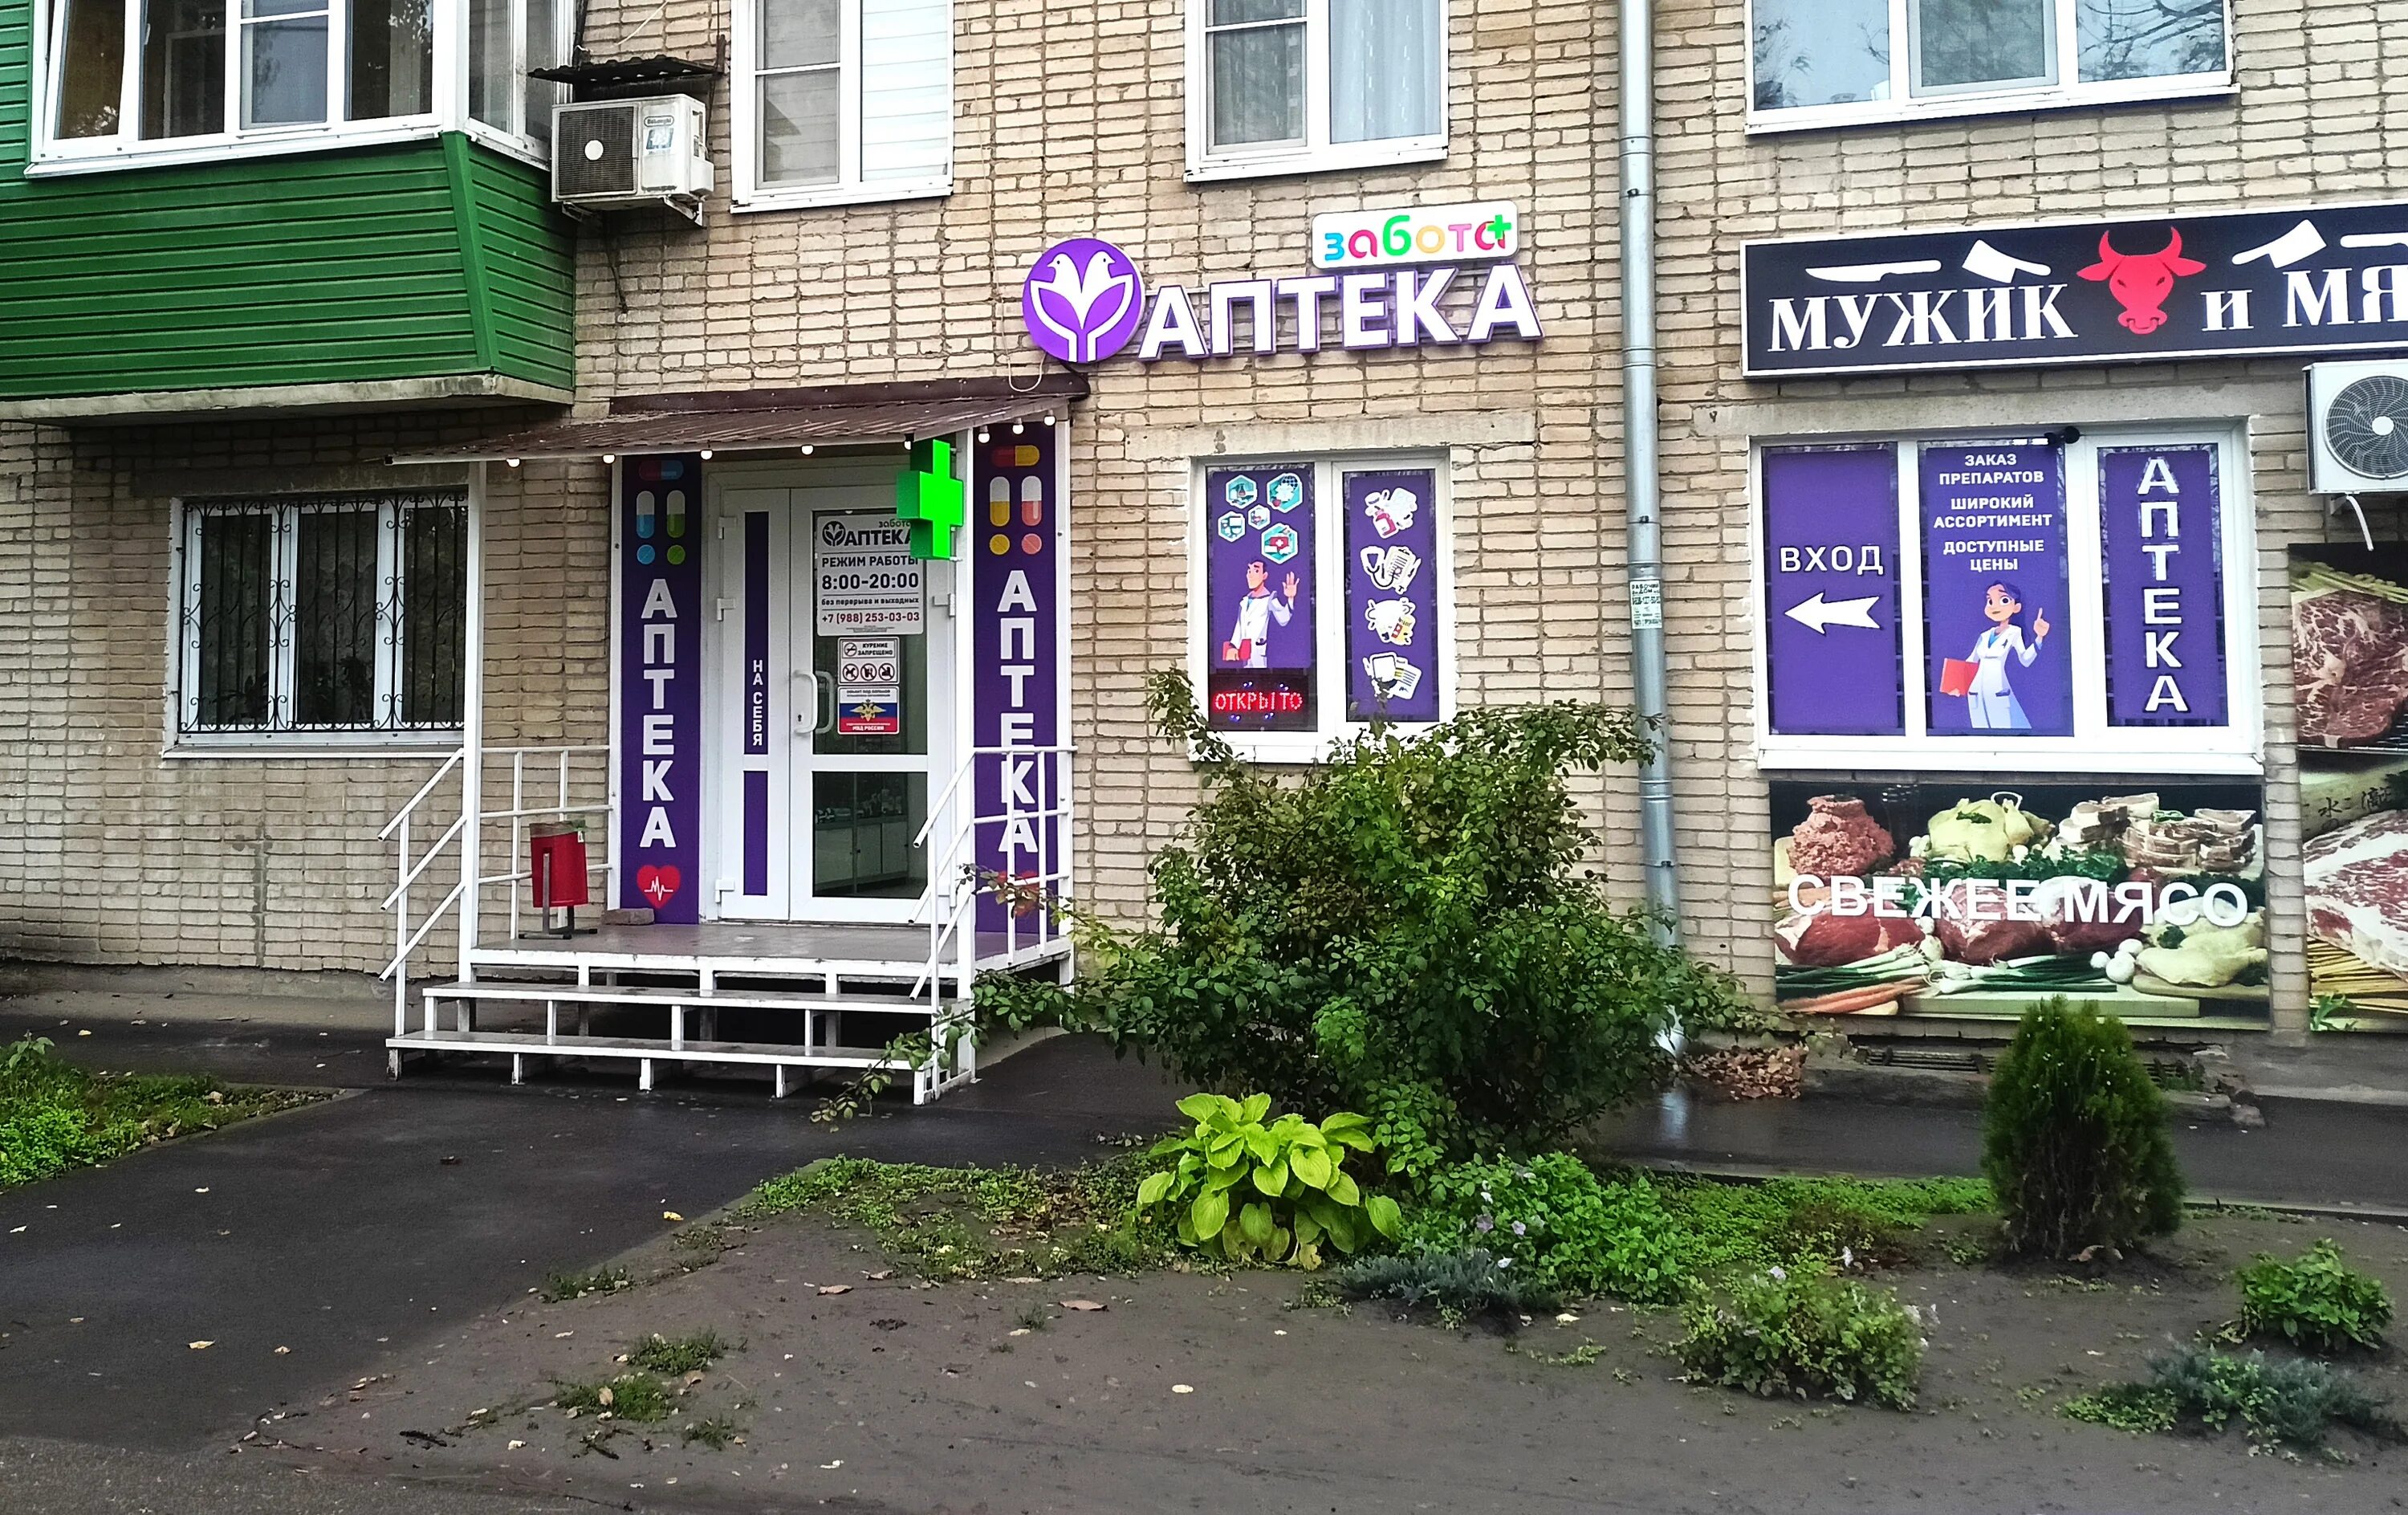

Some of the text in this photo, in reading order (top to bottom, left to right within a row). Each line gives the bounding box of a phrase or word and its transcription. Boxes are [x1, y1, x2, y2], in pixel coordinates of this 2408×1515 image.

[1138, 263, 1543, 360] АПТЕКА
[1767, 283, 2079, 352] МУЖИК
[2281, 263, 2408, 328] МЯ
[1964, 453, 2017, 466] ЗАКАЗ
[1939, 470, 2044, 485] ПРЕПАРАТОВ
[1950, 494, 2034, 510] ШИРОКИЙ
[1933, 514, 2052, 528] АССОРТИМЕНТ
[1942, 540, 2044, 555] ДОСТУПНЫЕ
[822, 555, 918, 568] РЕЖИМ РАБОТЫ
[1780, 544, 1884, 575] ВХОД
[1970, 558, 2018, 572] ЦЕНЫ
[822, 572, 919, 590] 8:00-20:00
[2137, 458, 2189, 713] АПТЕКА
[822, 612, 920, 624] +7 (988) 253-03-03
[752, 659, 763, 746] НА СЕБЯ
[1214, 692, 1303, 710] ОТКРЫТО
[640, 578, 678, 849] АПТЕКА
[998, 569, 1039, 853] АПТЕКА
[1788, 874, 2248, 927] СВЕЖЕЕ МЯСО
